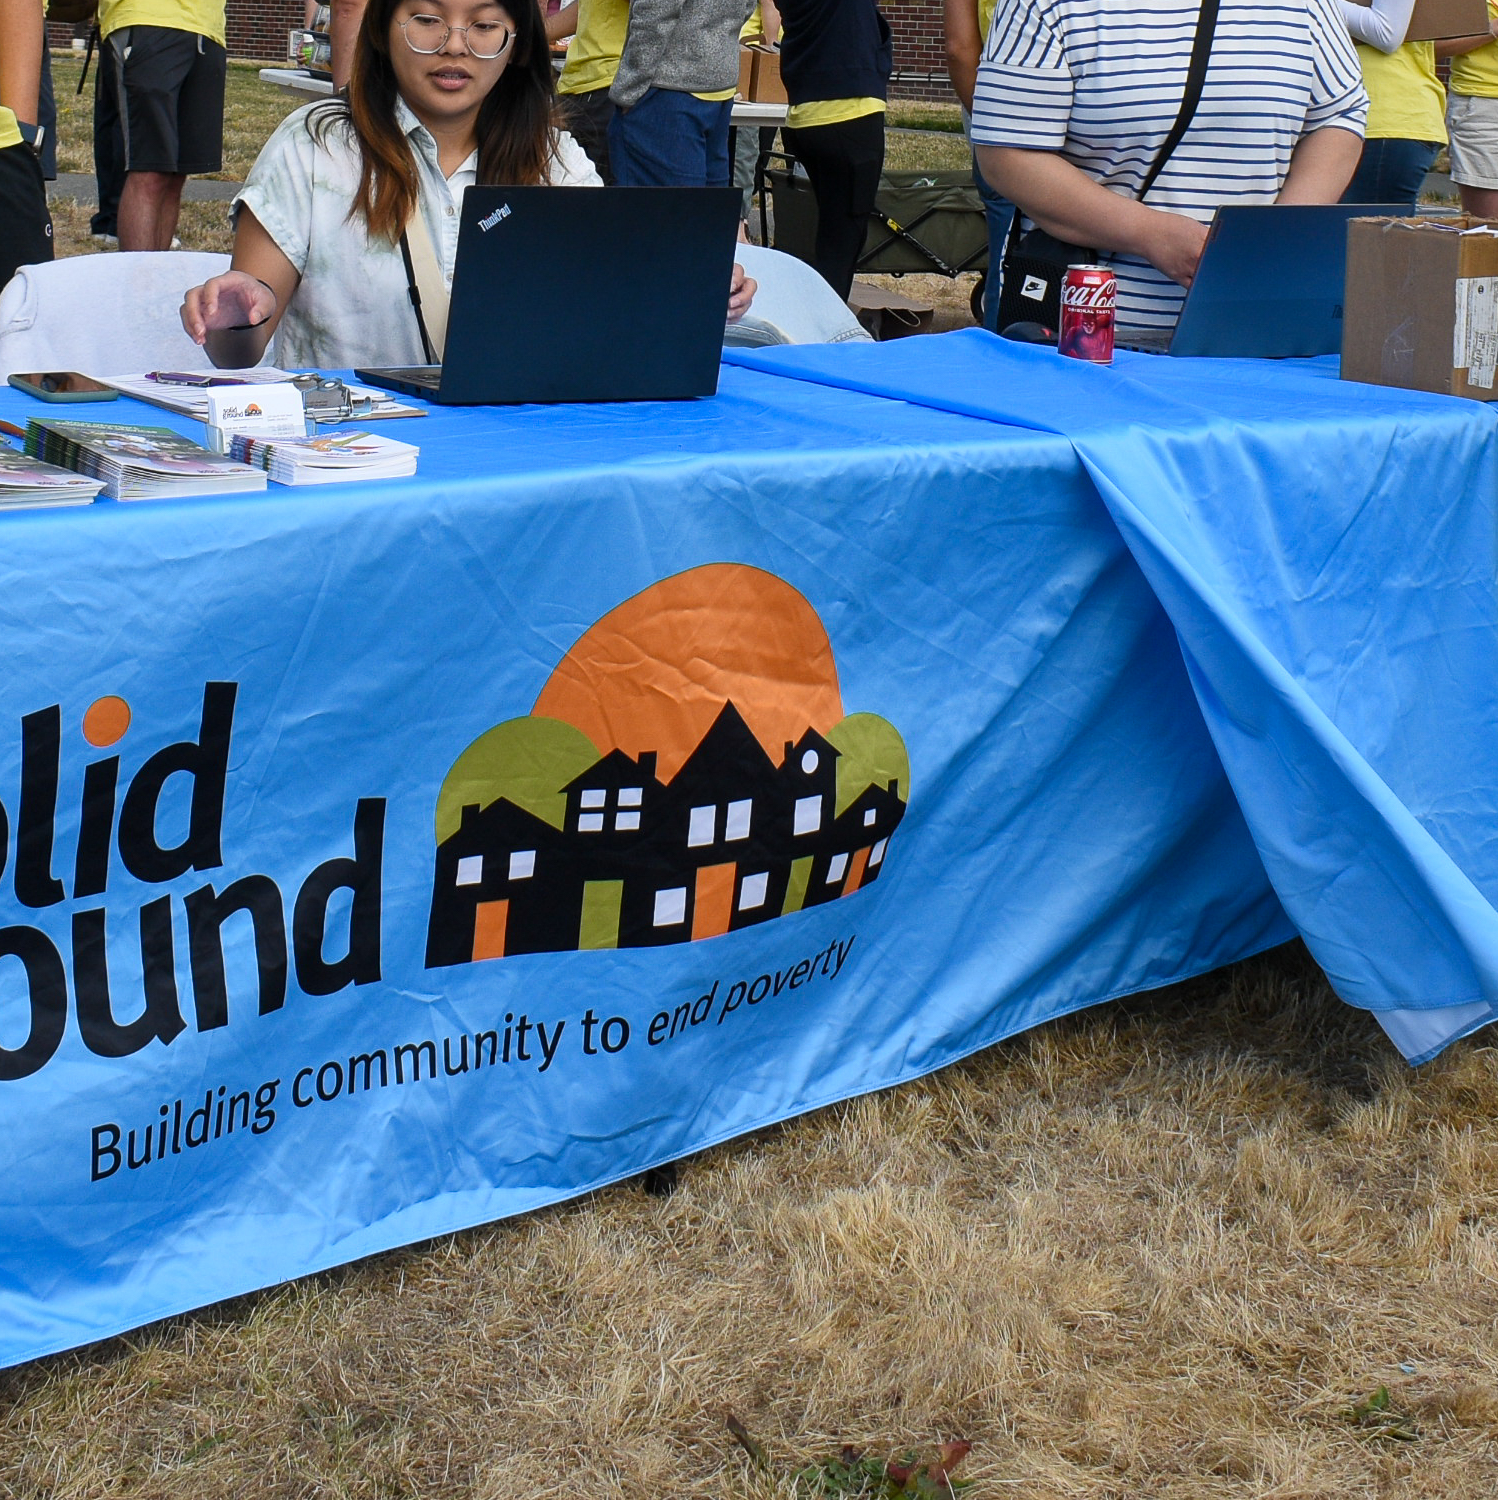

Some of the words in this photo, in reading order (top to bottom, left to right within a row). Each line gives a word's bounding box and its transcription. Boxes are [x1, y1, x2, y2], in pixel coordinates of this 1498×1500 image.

[477, 202, 512, 232] ThinkPad
[91, 1079, 281, 1182] Building
[291, 1011, 566, 1108] community
[580, 1009, 631, 1056] to
[647, 980, 719, 1046] end
[717, 934, 857, 1026] poverty
